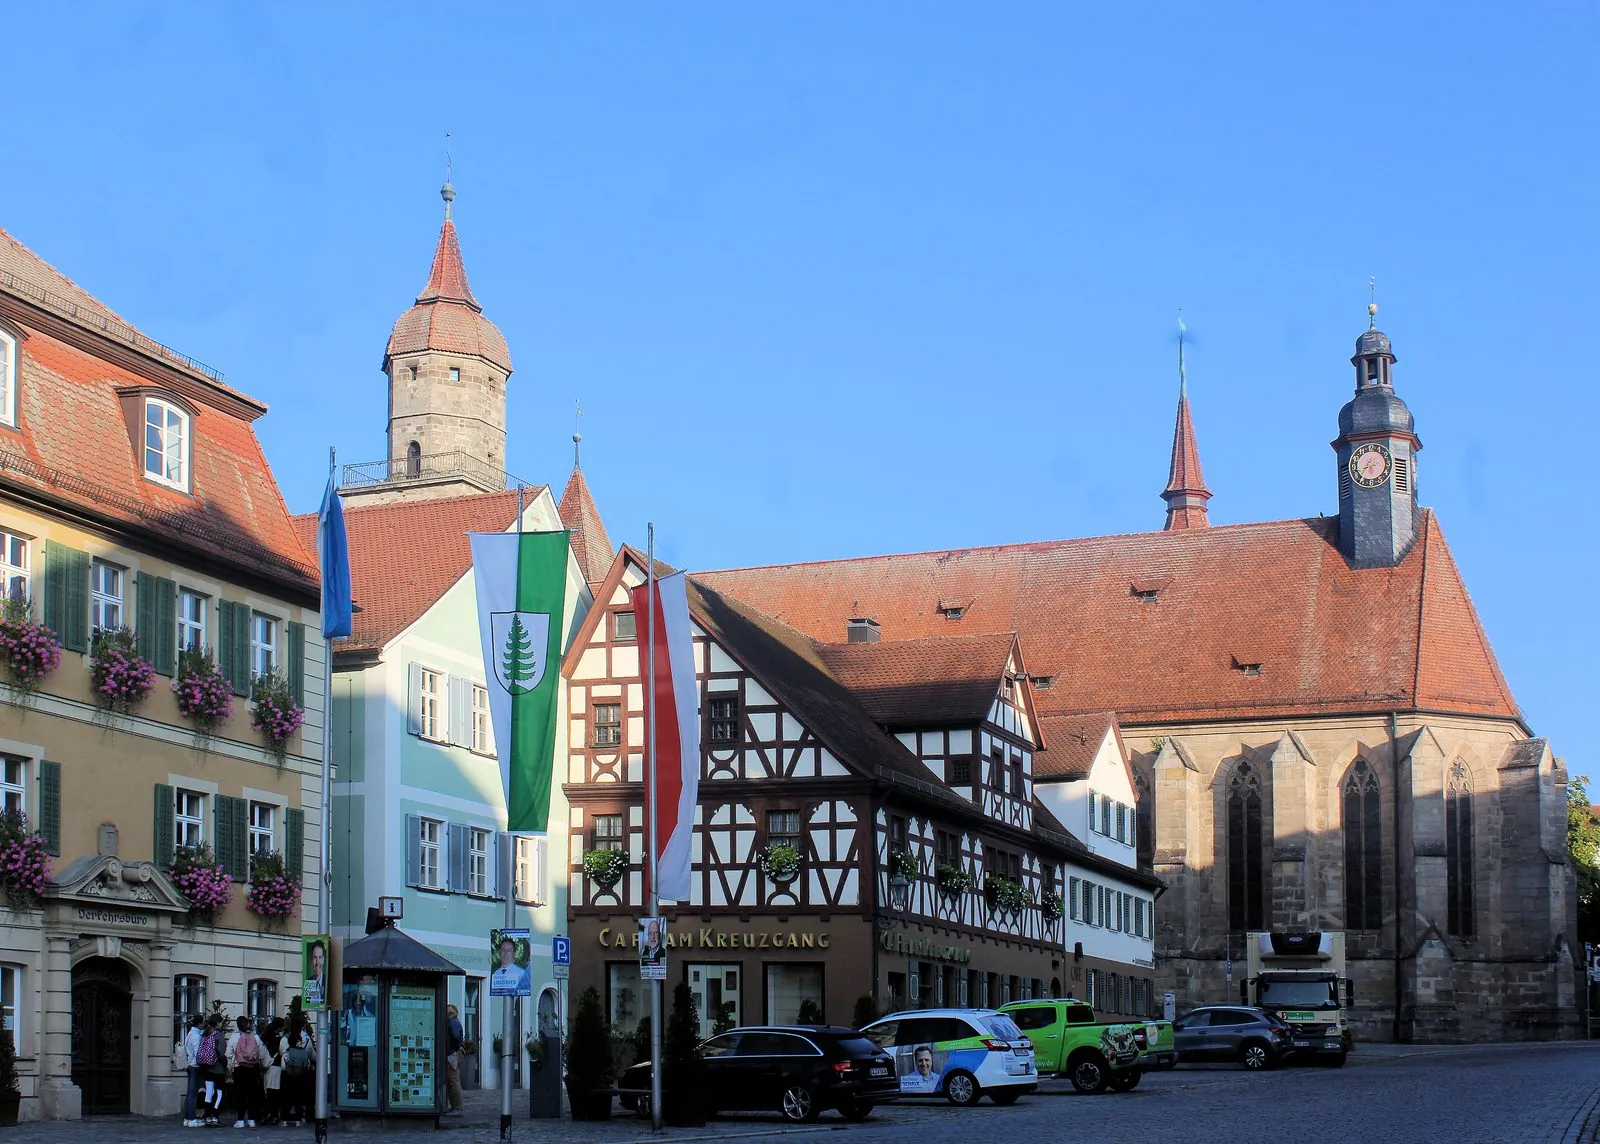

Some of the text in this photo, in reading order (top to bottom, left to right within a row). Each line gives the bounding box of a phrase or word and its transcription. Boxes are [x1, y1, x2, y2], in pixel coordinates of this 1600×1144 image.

[599, 927, 639, 948] CAF
[699, 927, 830, 948] KREUZGANG
[556, 940, 566, 961] P
